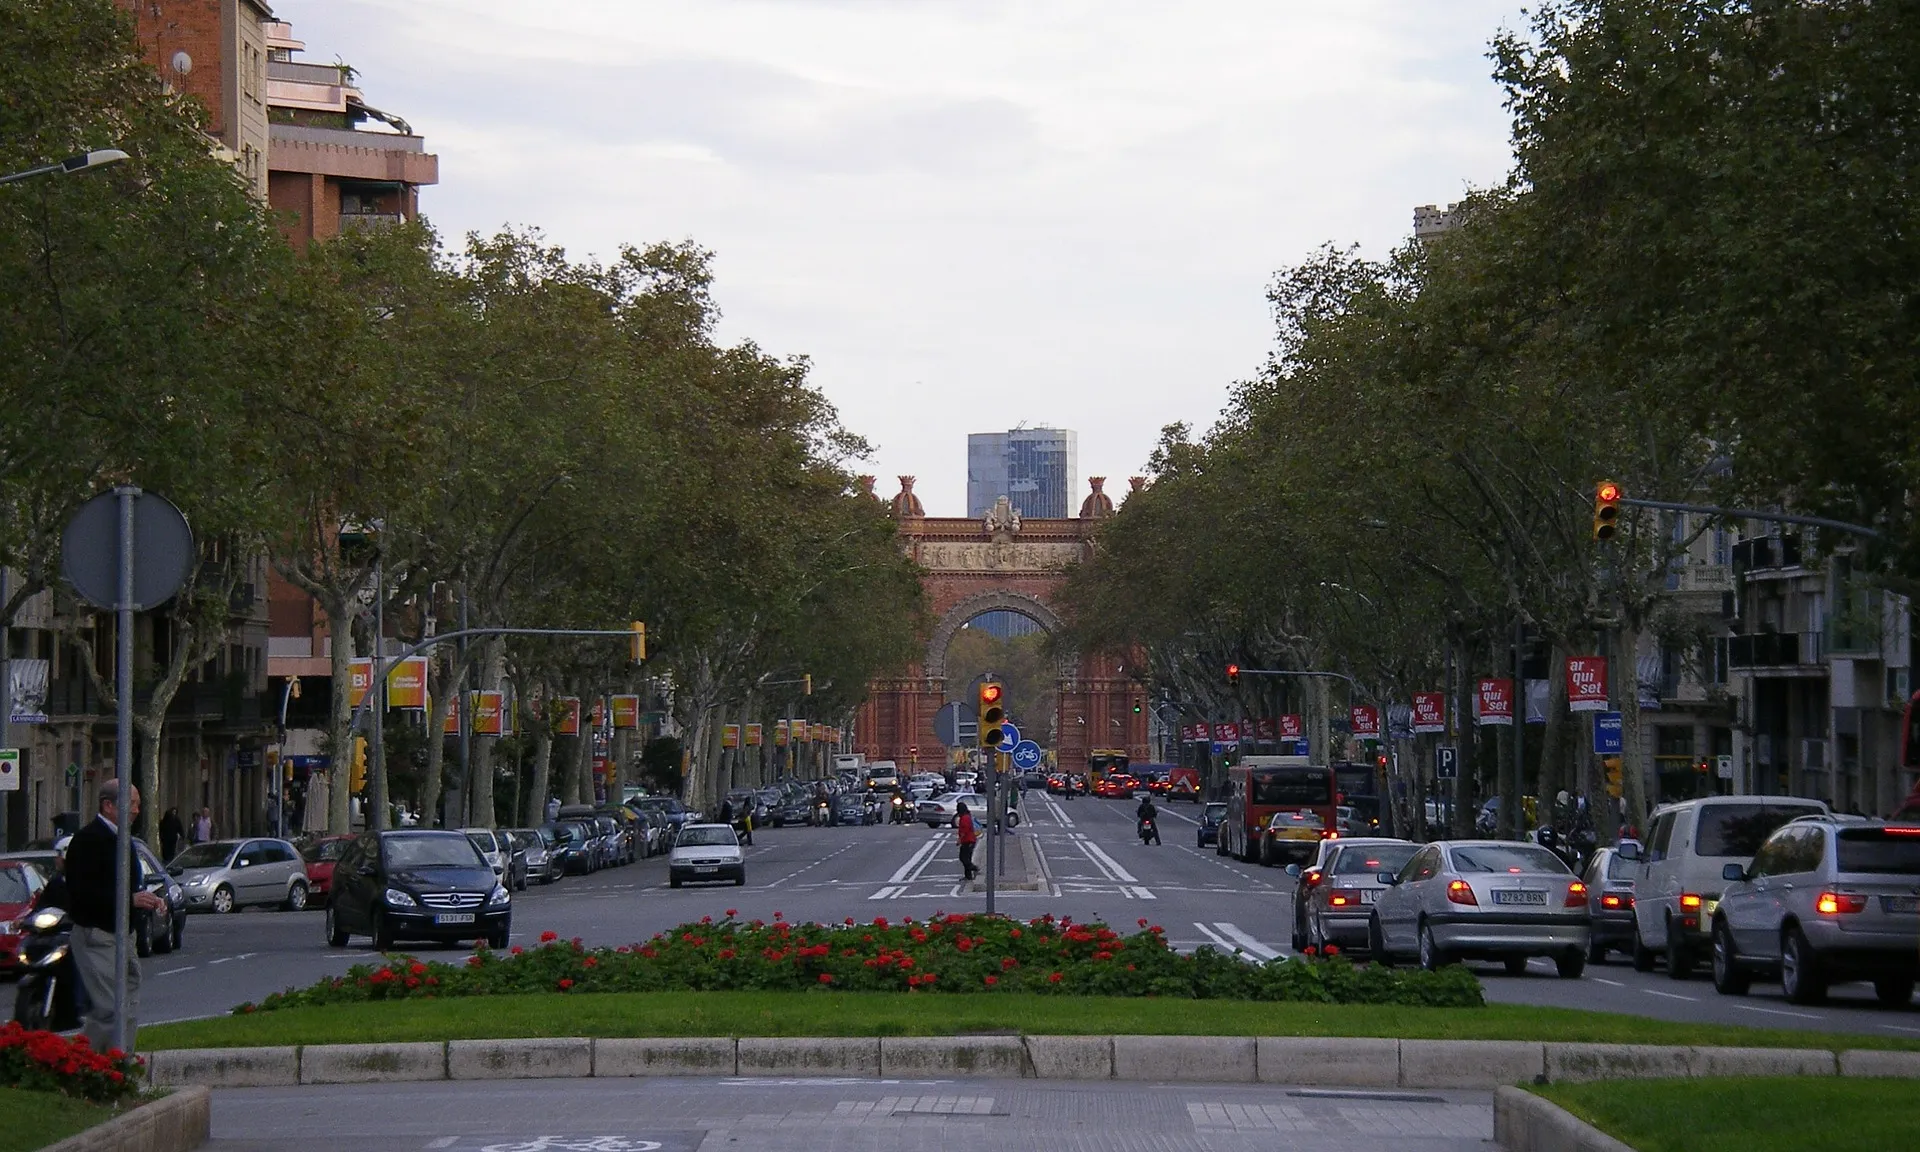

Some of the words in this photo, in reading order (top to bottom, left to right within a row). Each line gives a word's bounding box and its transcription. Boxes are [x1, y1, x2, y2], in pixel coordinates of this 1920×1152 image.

[1570, 660, 1584, 671] ar
[352, 674, 368, 687] B!
[1572, 668, 1594, 686] qui
[1481, 682, 1495, 692] ar
[1580, 682, 1602, 694] set
[1416, 696, 1428, 704] ar
[1483, 688, 1502, 704] qui
[1417, 701, 1434, 715] qui
[1489, 700, 1508, 711] set
[1353, 708, 1364, 716] ar
[1422, 711, 1440, 721] set
[1355, 713, 1369, 725] qui
[1359, 721, 1374, 730] set
[1605, 738, 1620, 747] taxi
[1442, 750, 1453, 767] P
[1501, 892, 1525, 902] 2782
